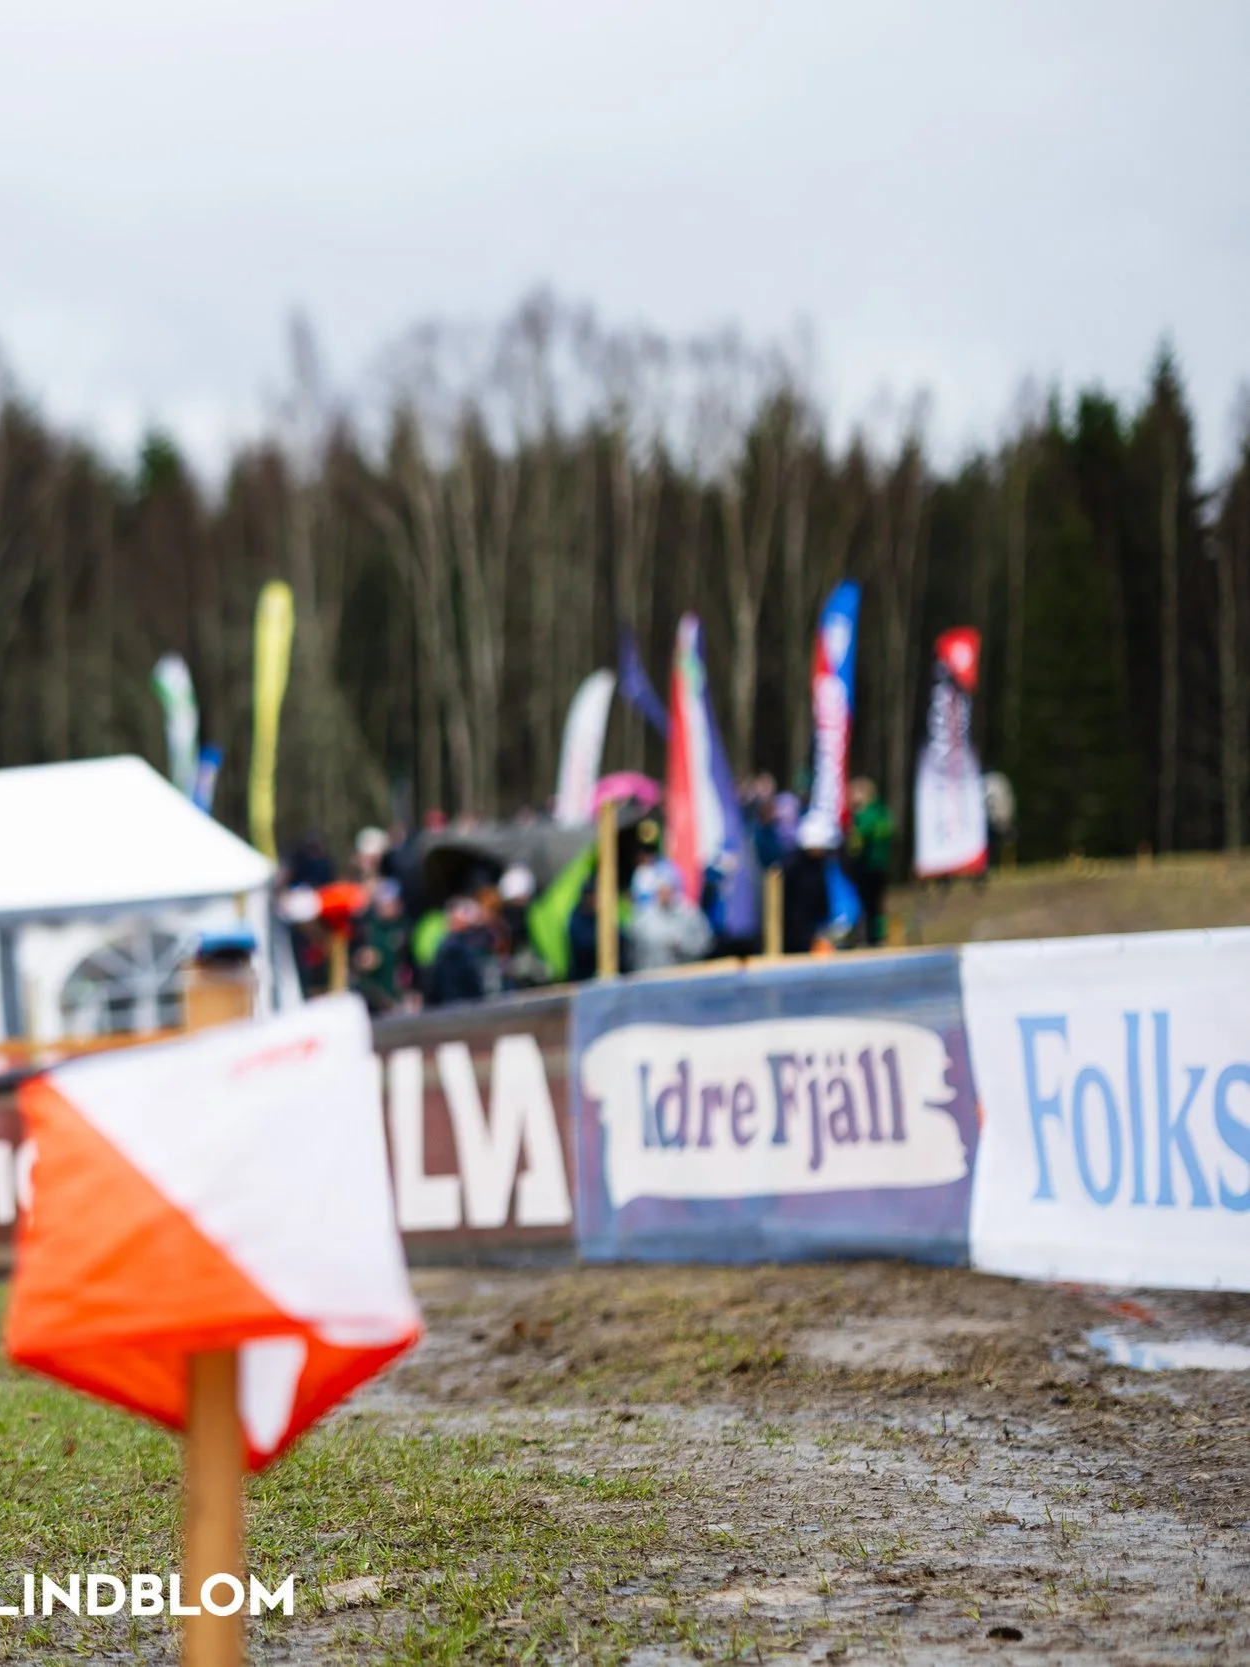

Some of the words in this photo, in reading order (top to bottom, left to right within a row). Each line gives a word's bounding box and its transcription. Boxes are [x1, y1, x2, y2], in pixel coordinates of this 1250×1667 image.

[376, 1033, 573, 1231] LVA
[639, 1058, 758, 1149] Idre
[767, 1048, 907, 1171] Fjäll
[1016, 1011, 1250, 1211] Folks
